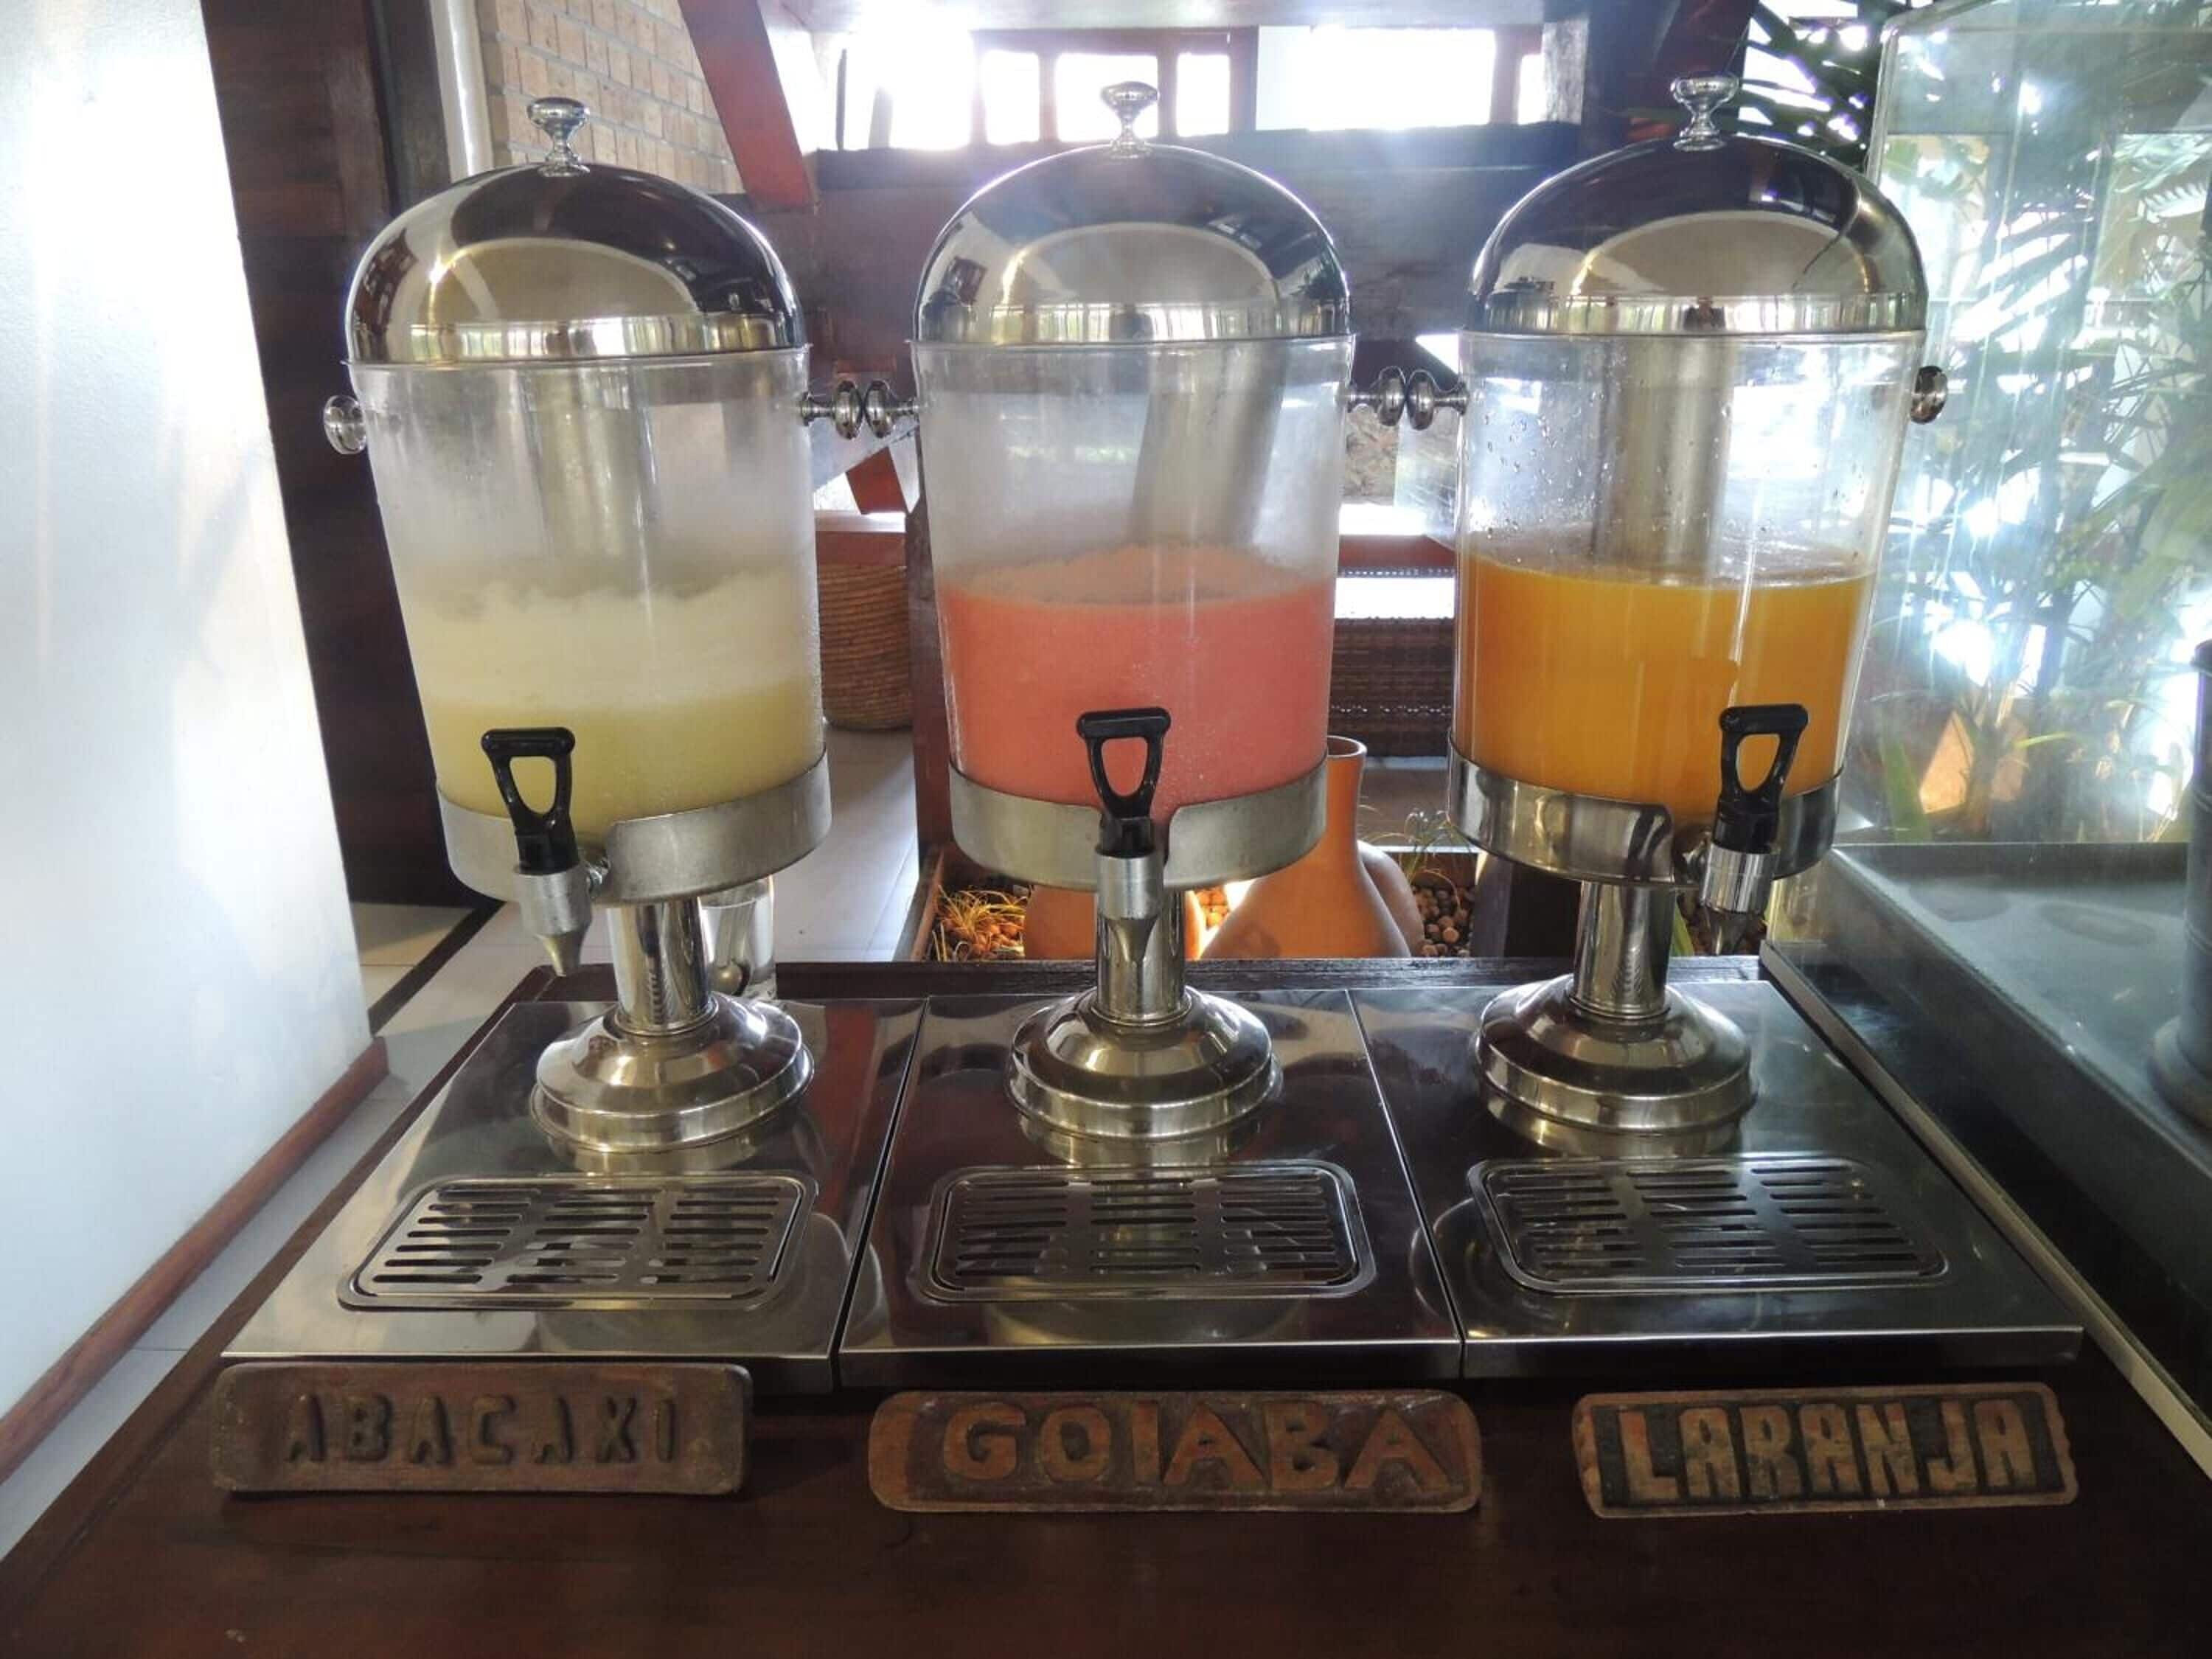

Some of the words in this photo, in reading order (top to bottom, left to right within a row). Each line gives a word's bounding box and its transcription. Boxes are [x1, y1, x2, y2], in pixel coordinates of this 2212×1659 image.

[288, 1393, 679, 1465] ABACAXI
[943, 1399, 1453, 1492] GOIABA
[1618, 1401, 2037, 1500] LARANJA
